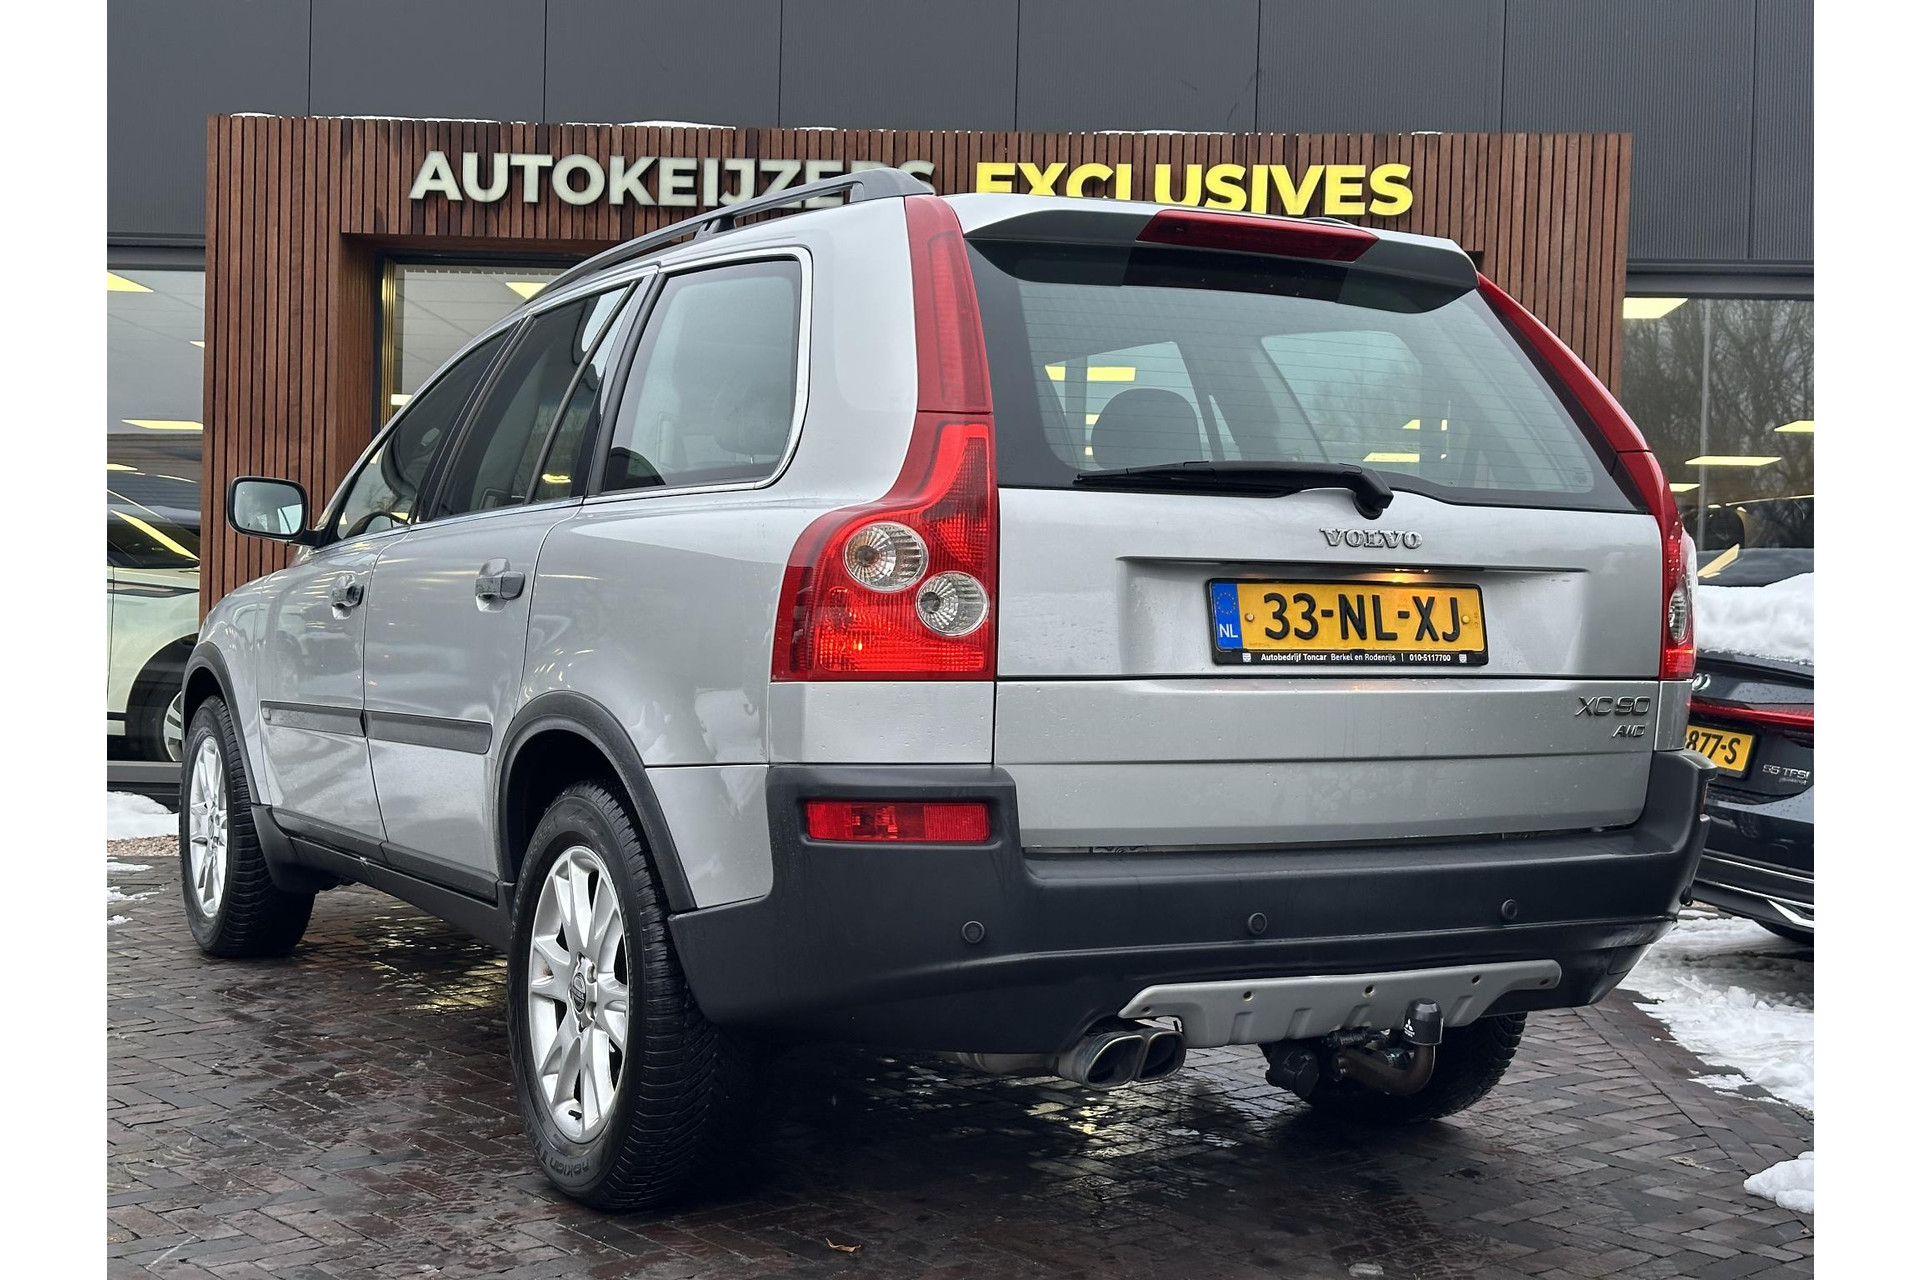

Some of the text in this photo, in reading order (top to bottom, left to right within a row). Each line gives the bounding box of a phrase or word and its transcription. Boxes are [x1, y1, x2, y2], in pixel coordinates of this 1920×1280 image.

[1319, 527, 1423, 549] VOLVO
[1263, 592, 1461, 642] 33-NL-XJ
[1219, 623, 1239, 639] NL
[1260, 652, 1301, 662] Autobedrijf
[1303, 653, 1327, 661] Toncar
[1330, 653, 1353, 661] Berkel
[1365, 654, 1396, 662] Rodenrijs
[1782, 767, 1811, 779] TFSI
